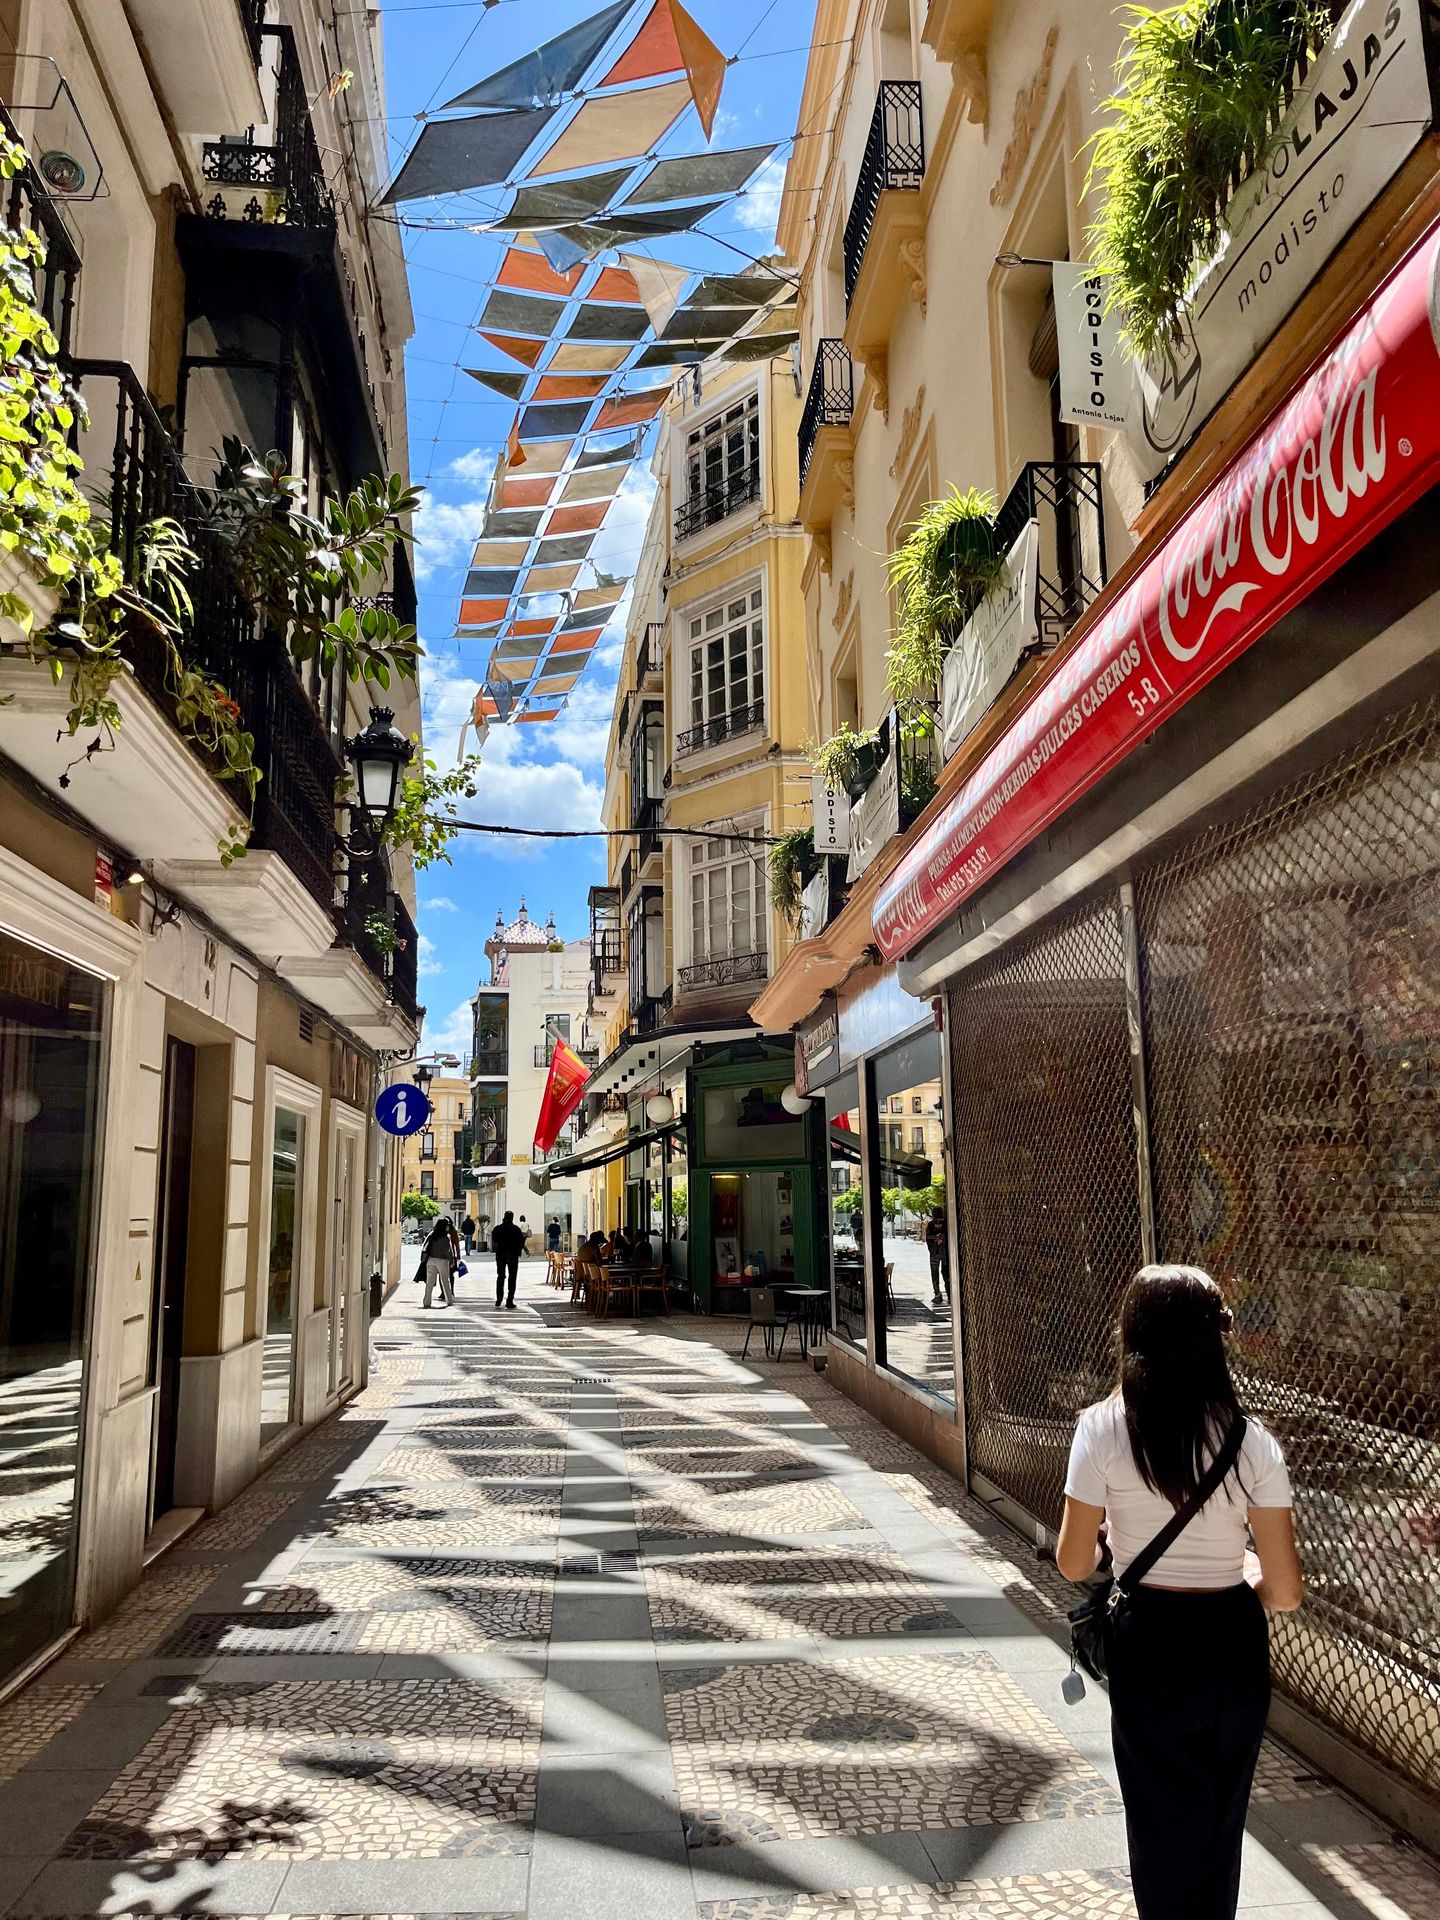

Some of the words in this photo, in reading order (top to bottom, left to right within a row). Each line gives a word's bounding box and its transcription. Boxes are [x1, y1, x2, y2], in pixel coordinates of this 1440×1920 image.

[1238, 173, 1345, 313] modisto
[1084, 274, 1106, 407] MODISTO
[1071, 407, 1103, 419] Antonio
[1103, 412, 1126, 424] Lajas
[1081, 639, 1141, 717] CASEROS
[1127, 677, 1160, 717] 5-B
[826, 785, 837, 844] ODISTO
[967, 855, 982, 874] 33
[975, 845, 991, 863] 87
